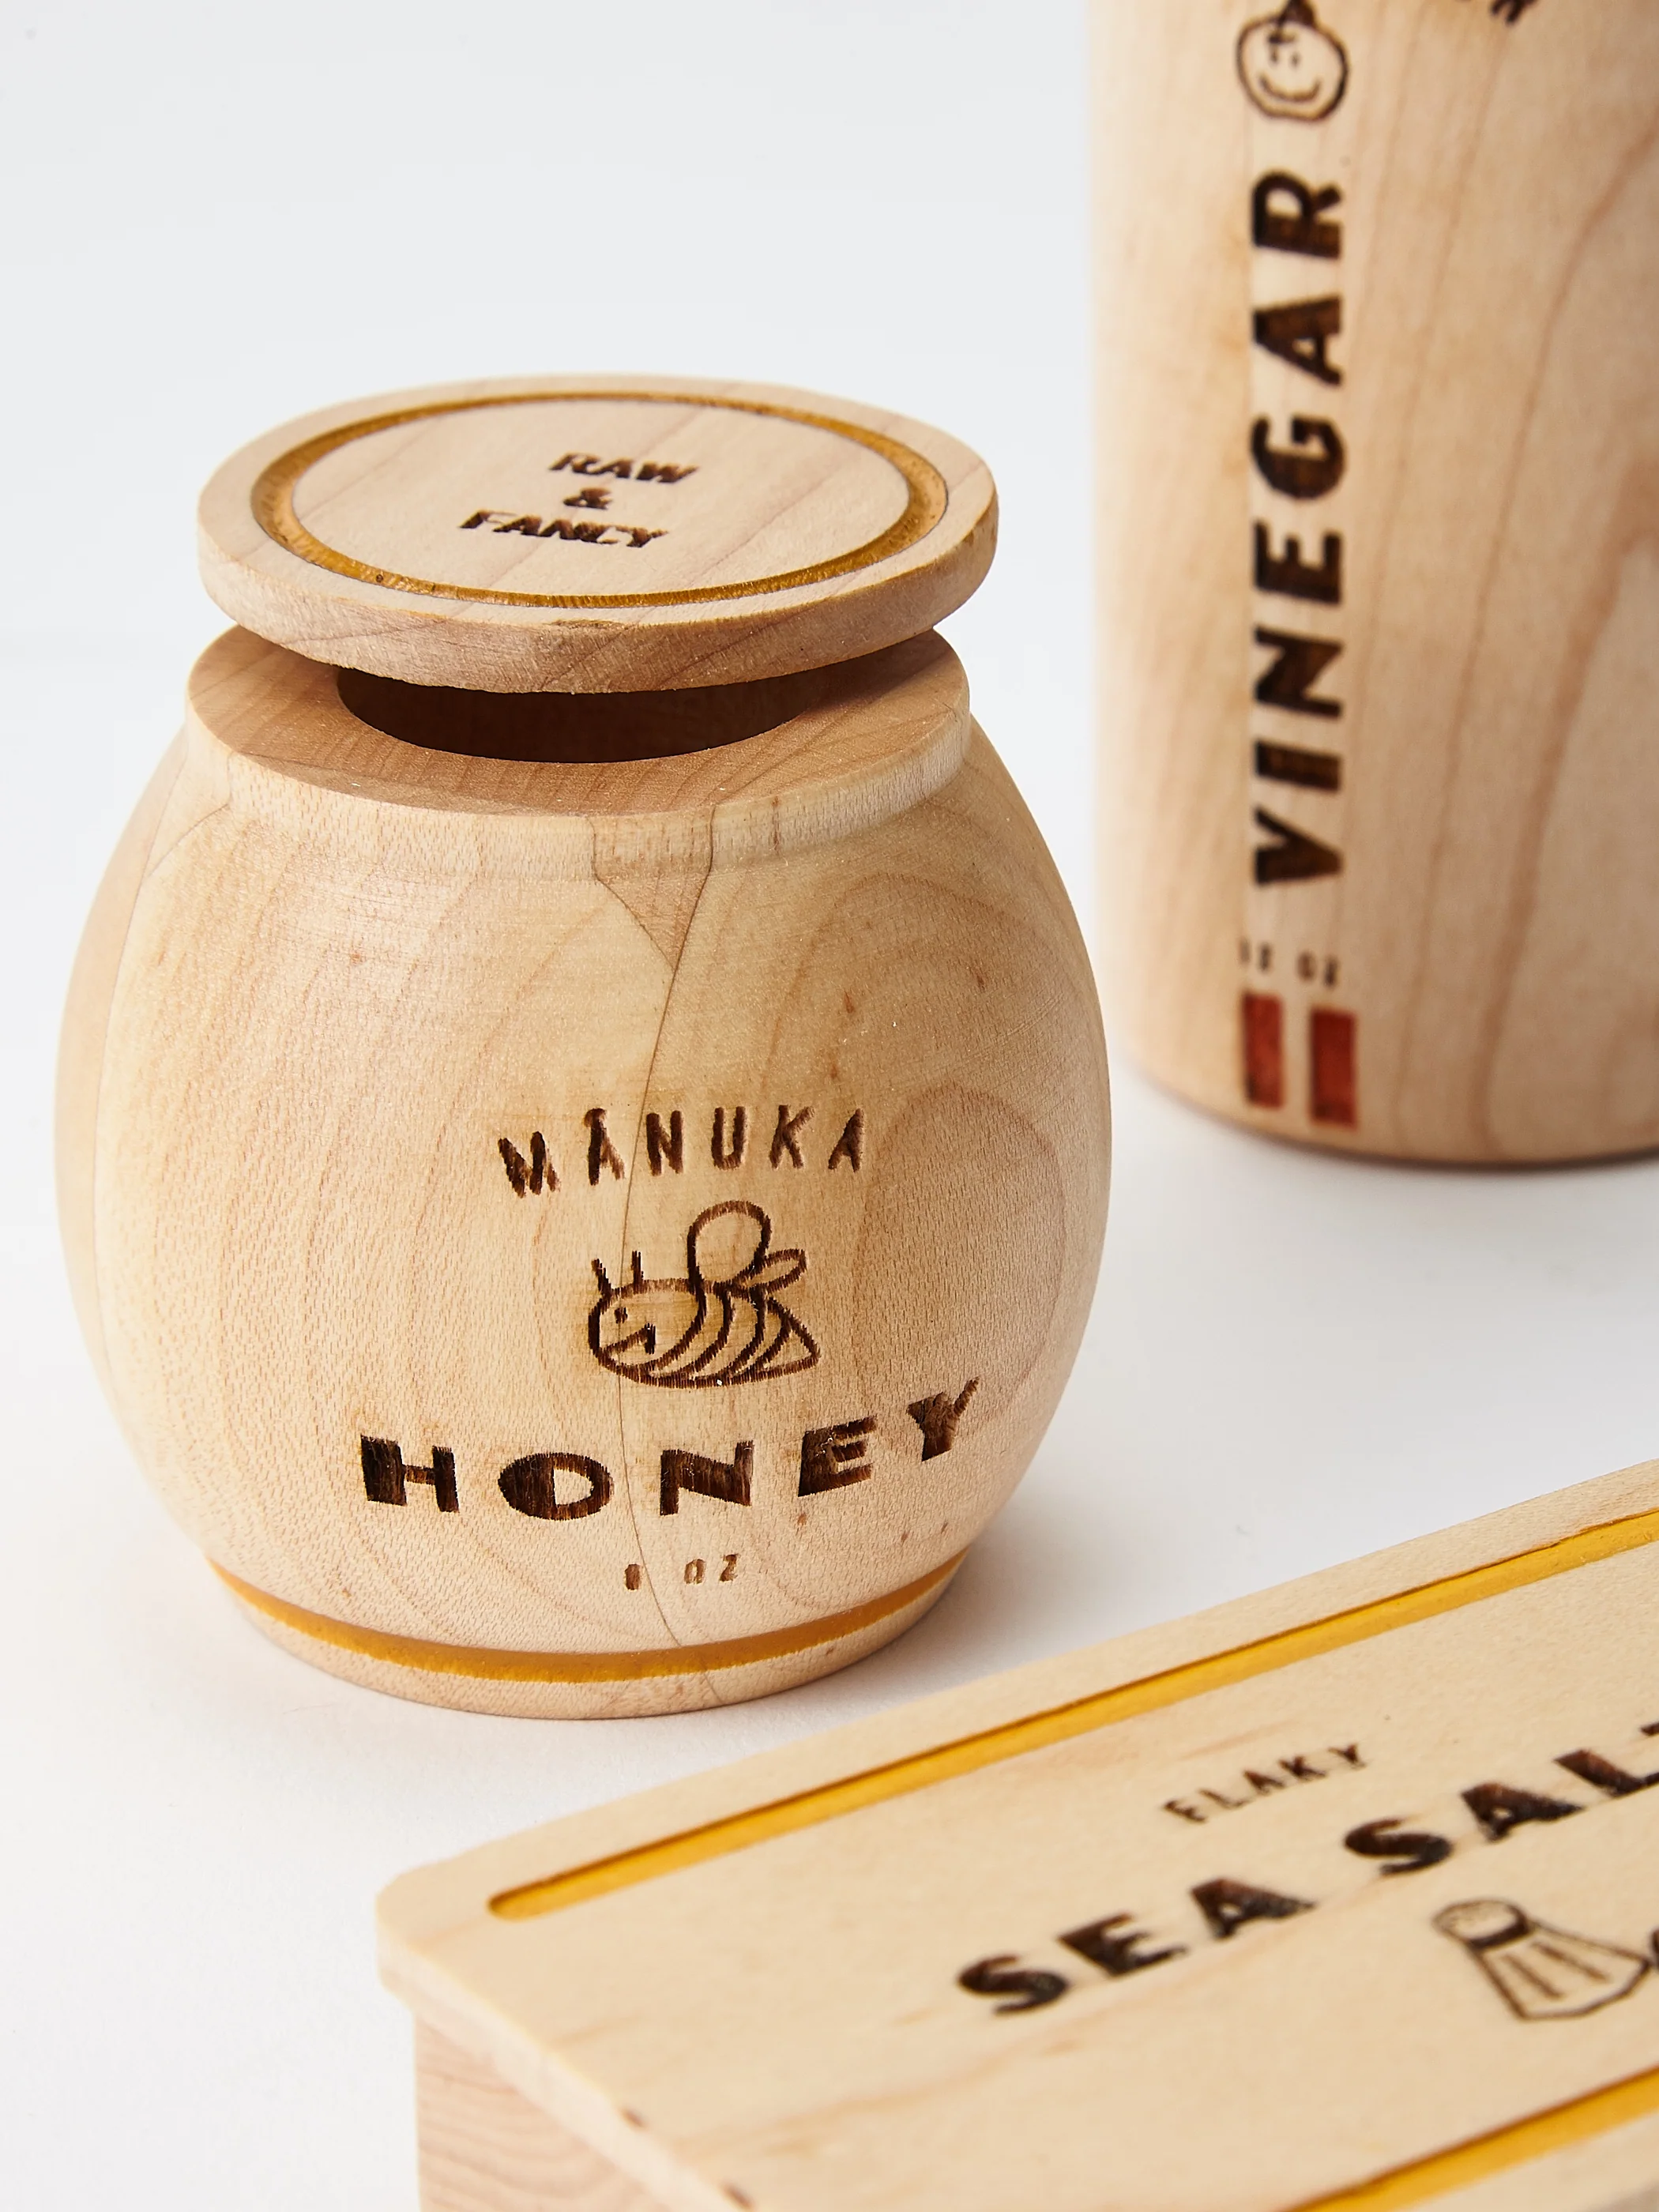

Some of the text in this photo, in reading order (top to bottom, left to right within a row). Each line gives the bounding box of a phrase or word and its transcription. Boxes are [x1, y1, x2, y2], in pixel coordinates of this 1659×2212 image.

[548, 453, 700, 483] RAW
[562, 487, 612, 510] &
[458, 510, 668, 548] FANCY
[1248, 170, 1347, 888] VINEGAR
[360, 1378, 980, 1521] HONEY
[683, 1552, 740, 1585] OZ
[1161, 1742, 1367, 1824] FLAKY
[956, 1722, 1659, 2015] SEA SAL
